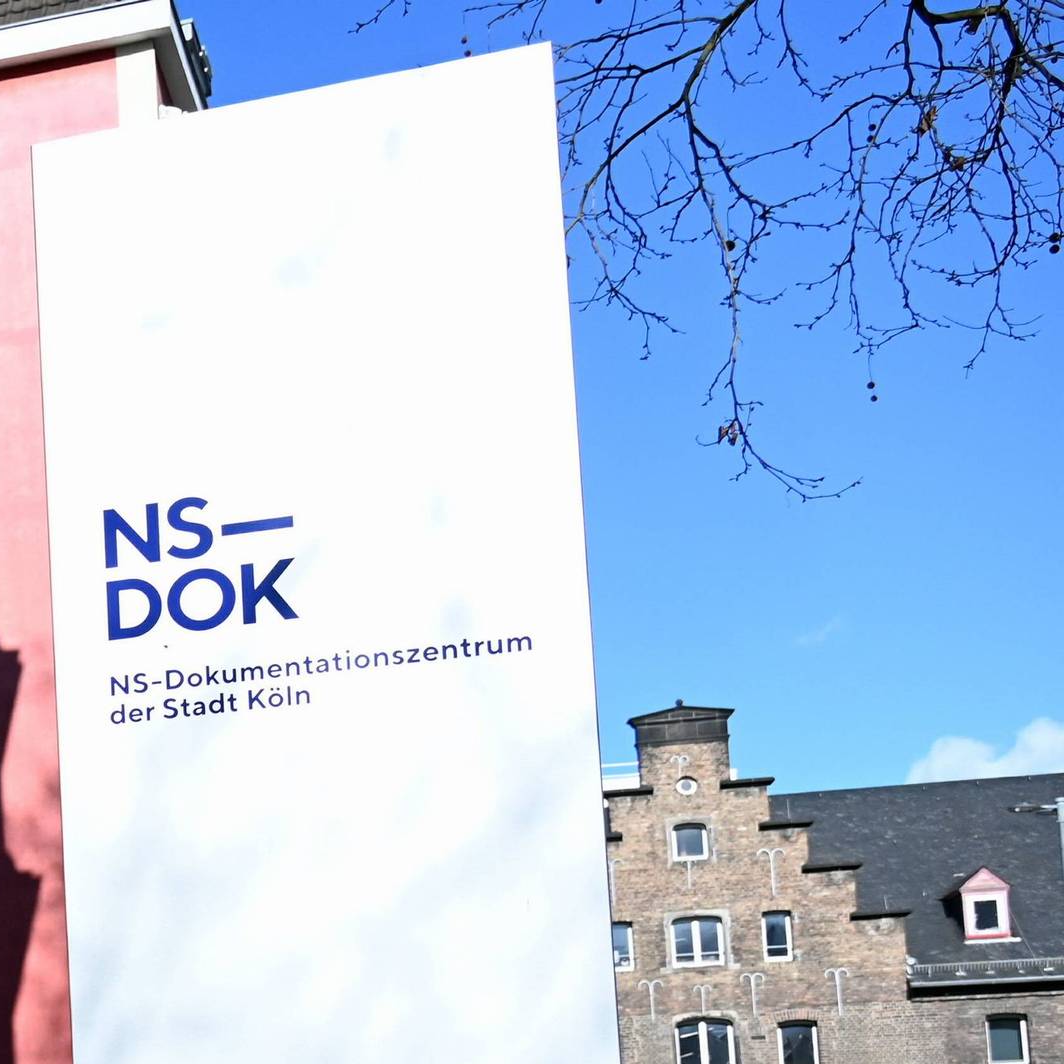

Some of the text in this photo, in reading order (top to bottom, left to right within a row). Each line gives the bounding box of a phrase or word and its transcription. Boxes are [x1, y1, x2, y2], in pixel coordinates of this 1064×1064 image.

[107, 557, 299, 641] DOK
[110, 632, 533, 696] NS-Dokumentationszentrum
[110, 687, 311, 725] der Stadt Köln
